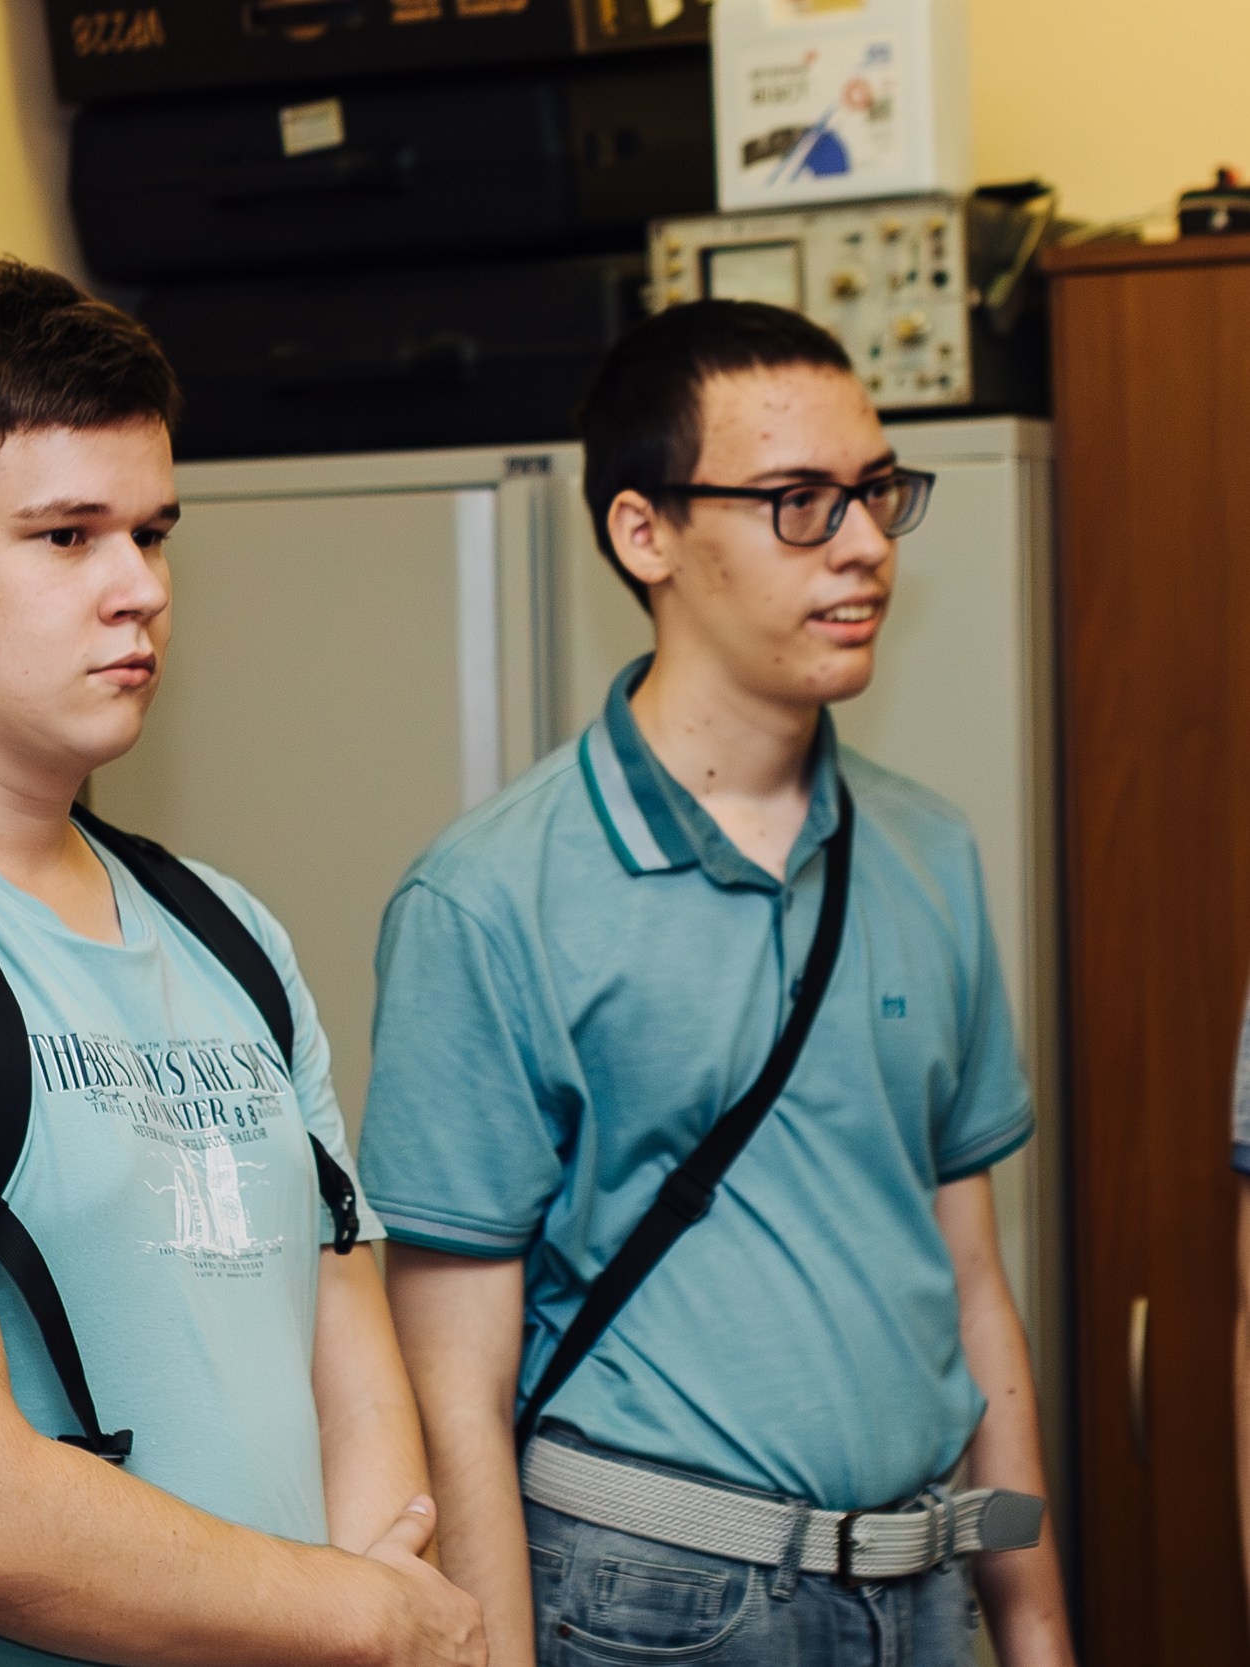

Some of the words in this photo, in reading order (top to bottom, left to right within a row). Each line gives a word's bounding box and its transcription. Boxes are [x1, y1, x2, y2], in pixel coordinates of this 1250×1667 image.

[28, 1032, 99, 1093] THE
[187, 1047, 241, 1096] ARE
[228, 1126, 268, 1146] SAILOR
